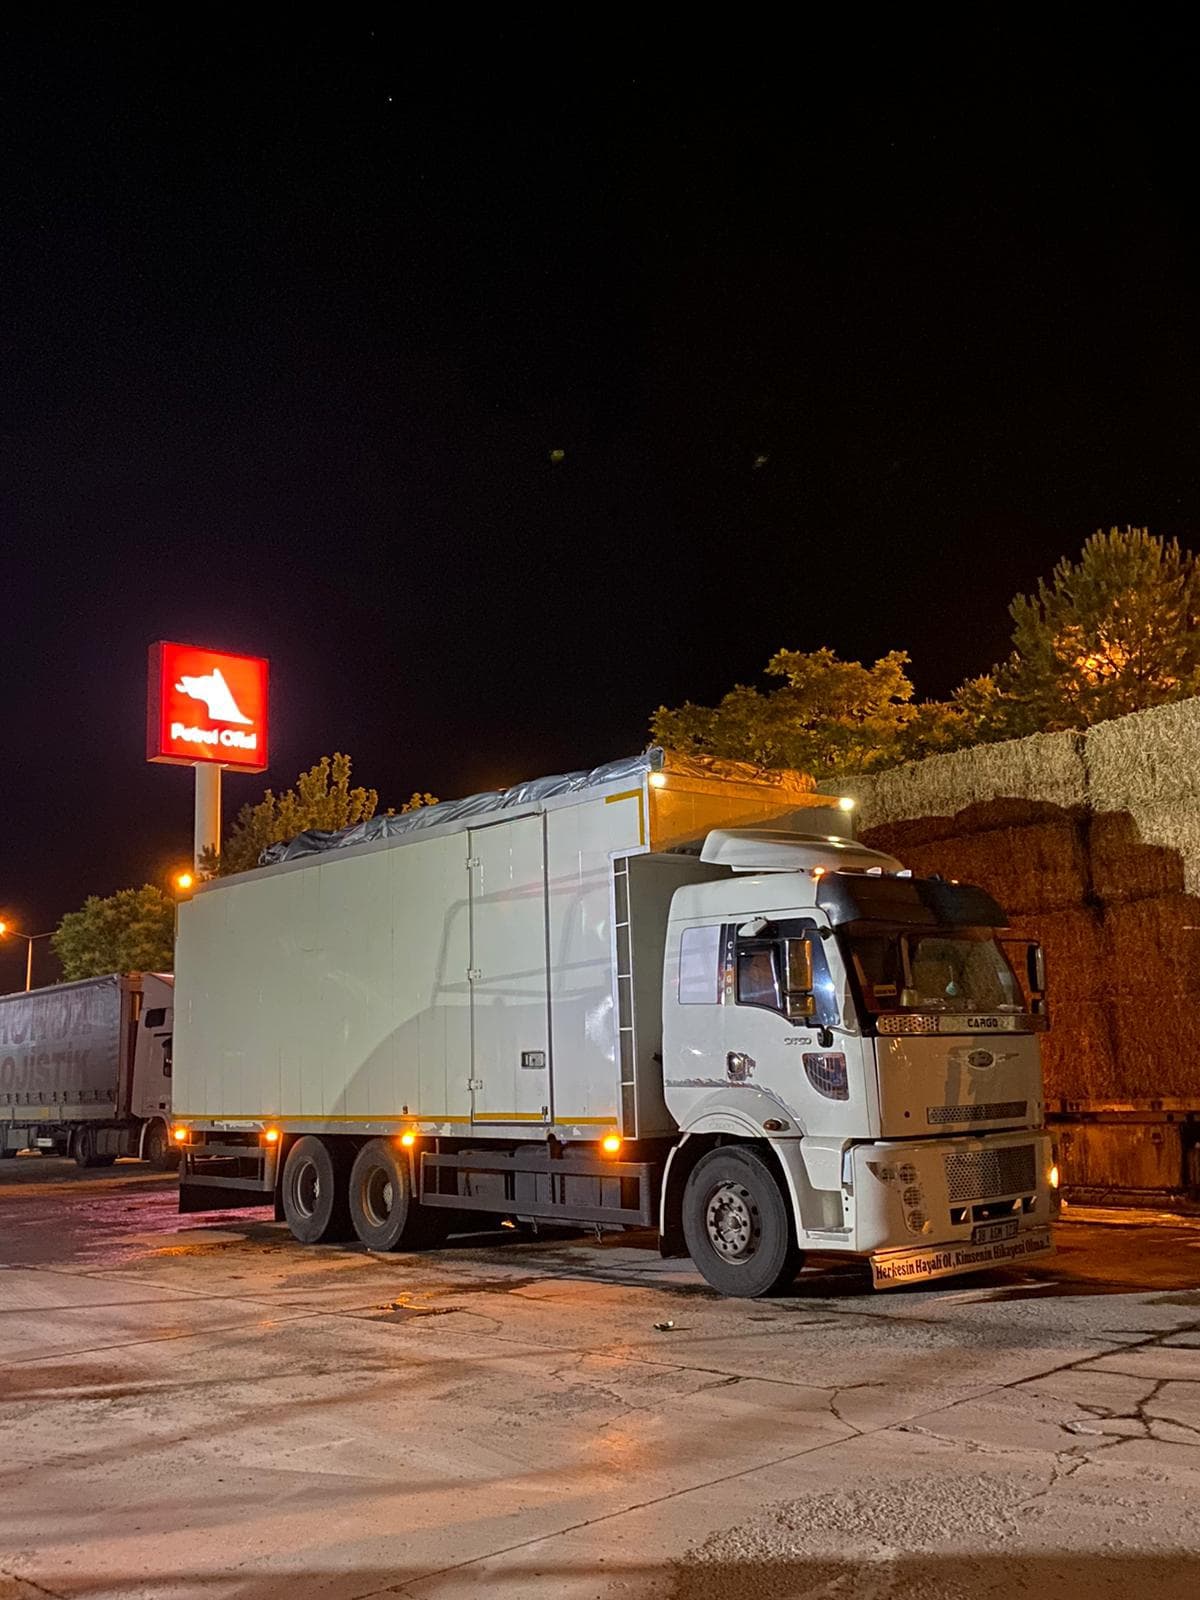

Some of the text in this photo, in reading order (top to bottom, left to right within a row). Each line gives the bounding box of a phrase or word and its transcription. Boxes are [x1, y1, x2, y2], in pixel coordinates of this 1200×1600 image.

[726, 941, 734, 994] CARGO
[967, 1017, 998, 1028] CARGO
[876, 1261, 915, 1280] Herkesin
[956, 1247, 992, 1266] Kimsenin
